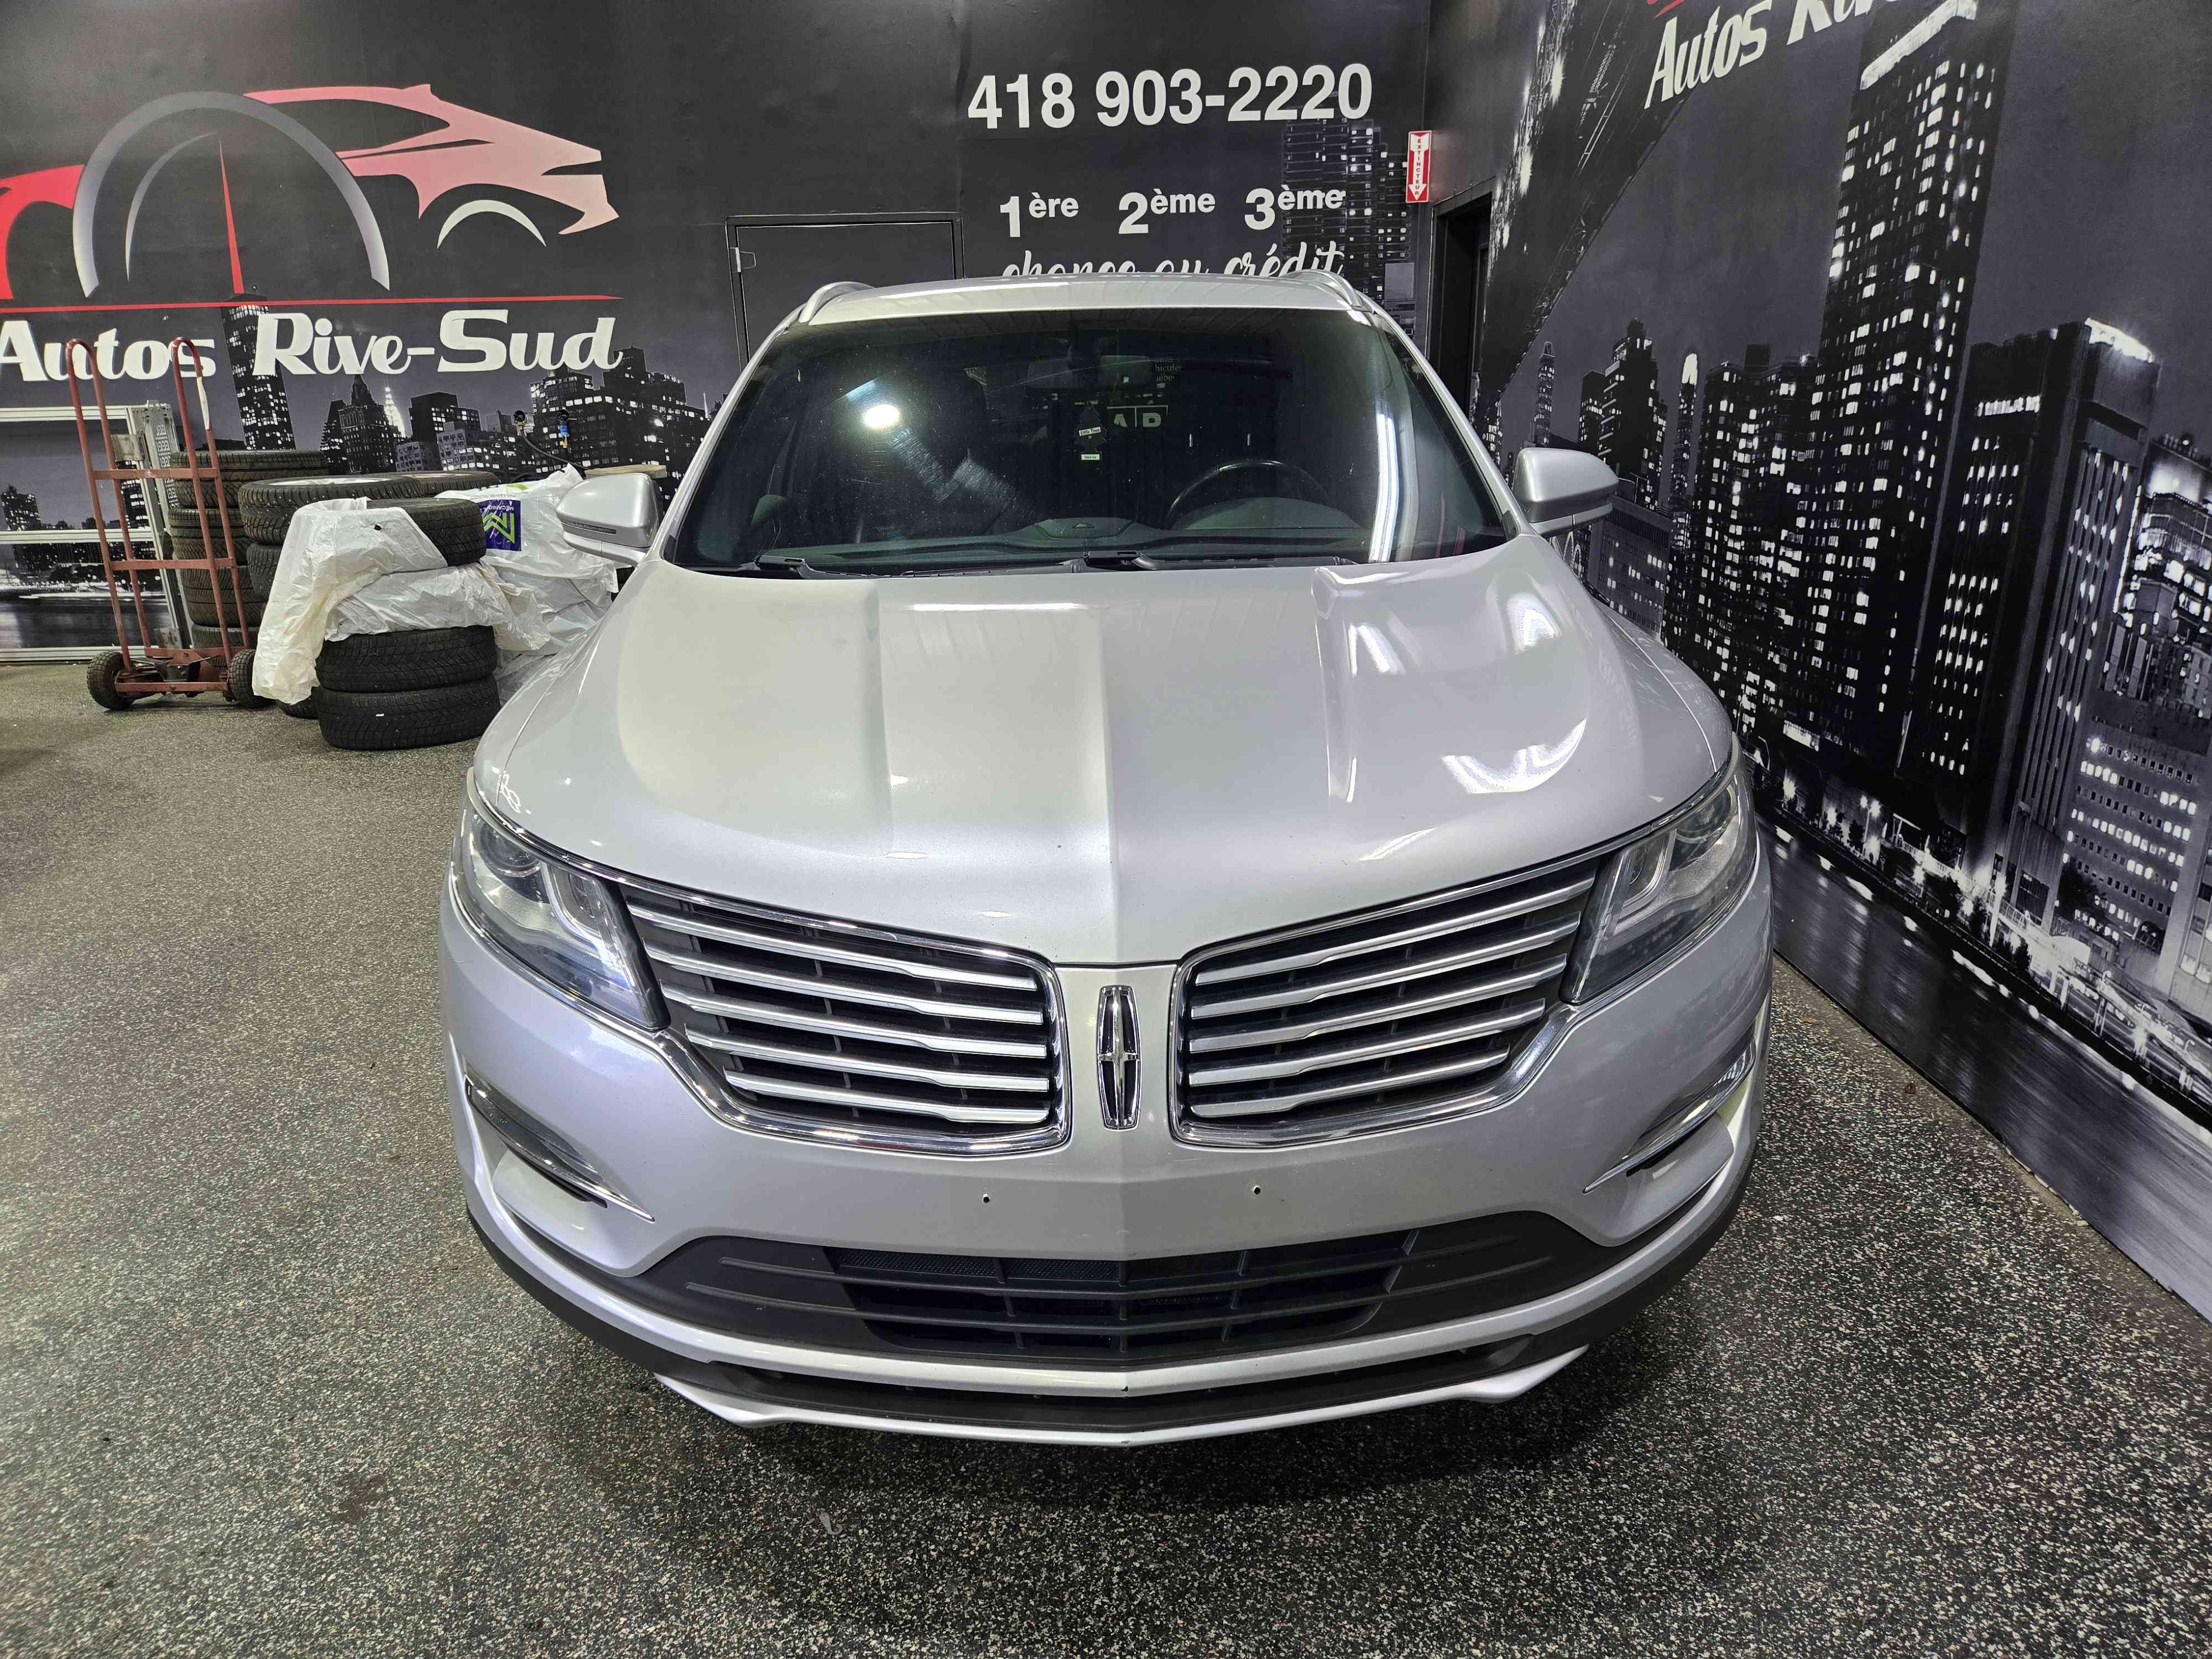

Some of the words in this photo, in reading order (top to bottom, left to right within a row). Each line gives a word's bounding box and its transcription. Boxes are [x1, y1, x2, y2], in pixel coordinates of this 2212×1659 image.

[1644, 0, 1772, 109] Autos
[968, 72, 1075, 129] 418
[1095, 64, 1373, 127] 903-2220
[1000, 192, 1079, 238] 1ère
[1118, 189, 1215, 234] 2ème
[1244, 184, 1347, 230] 3ème
[0, 320, 216, 382] Autos
[252, 309, 624, 375] Rive-Sud
